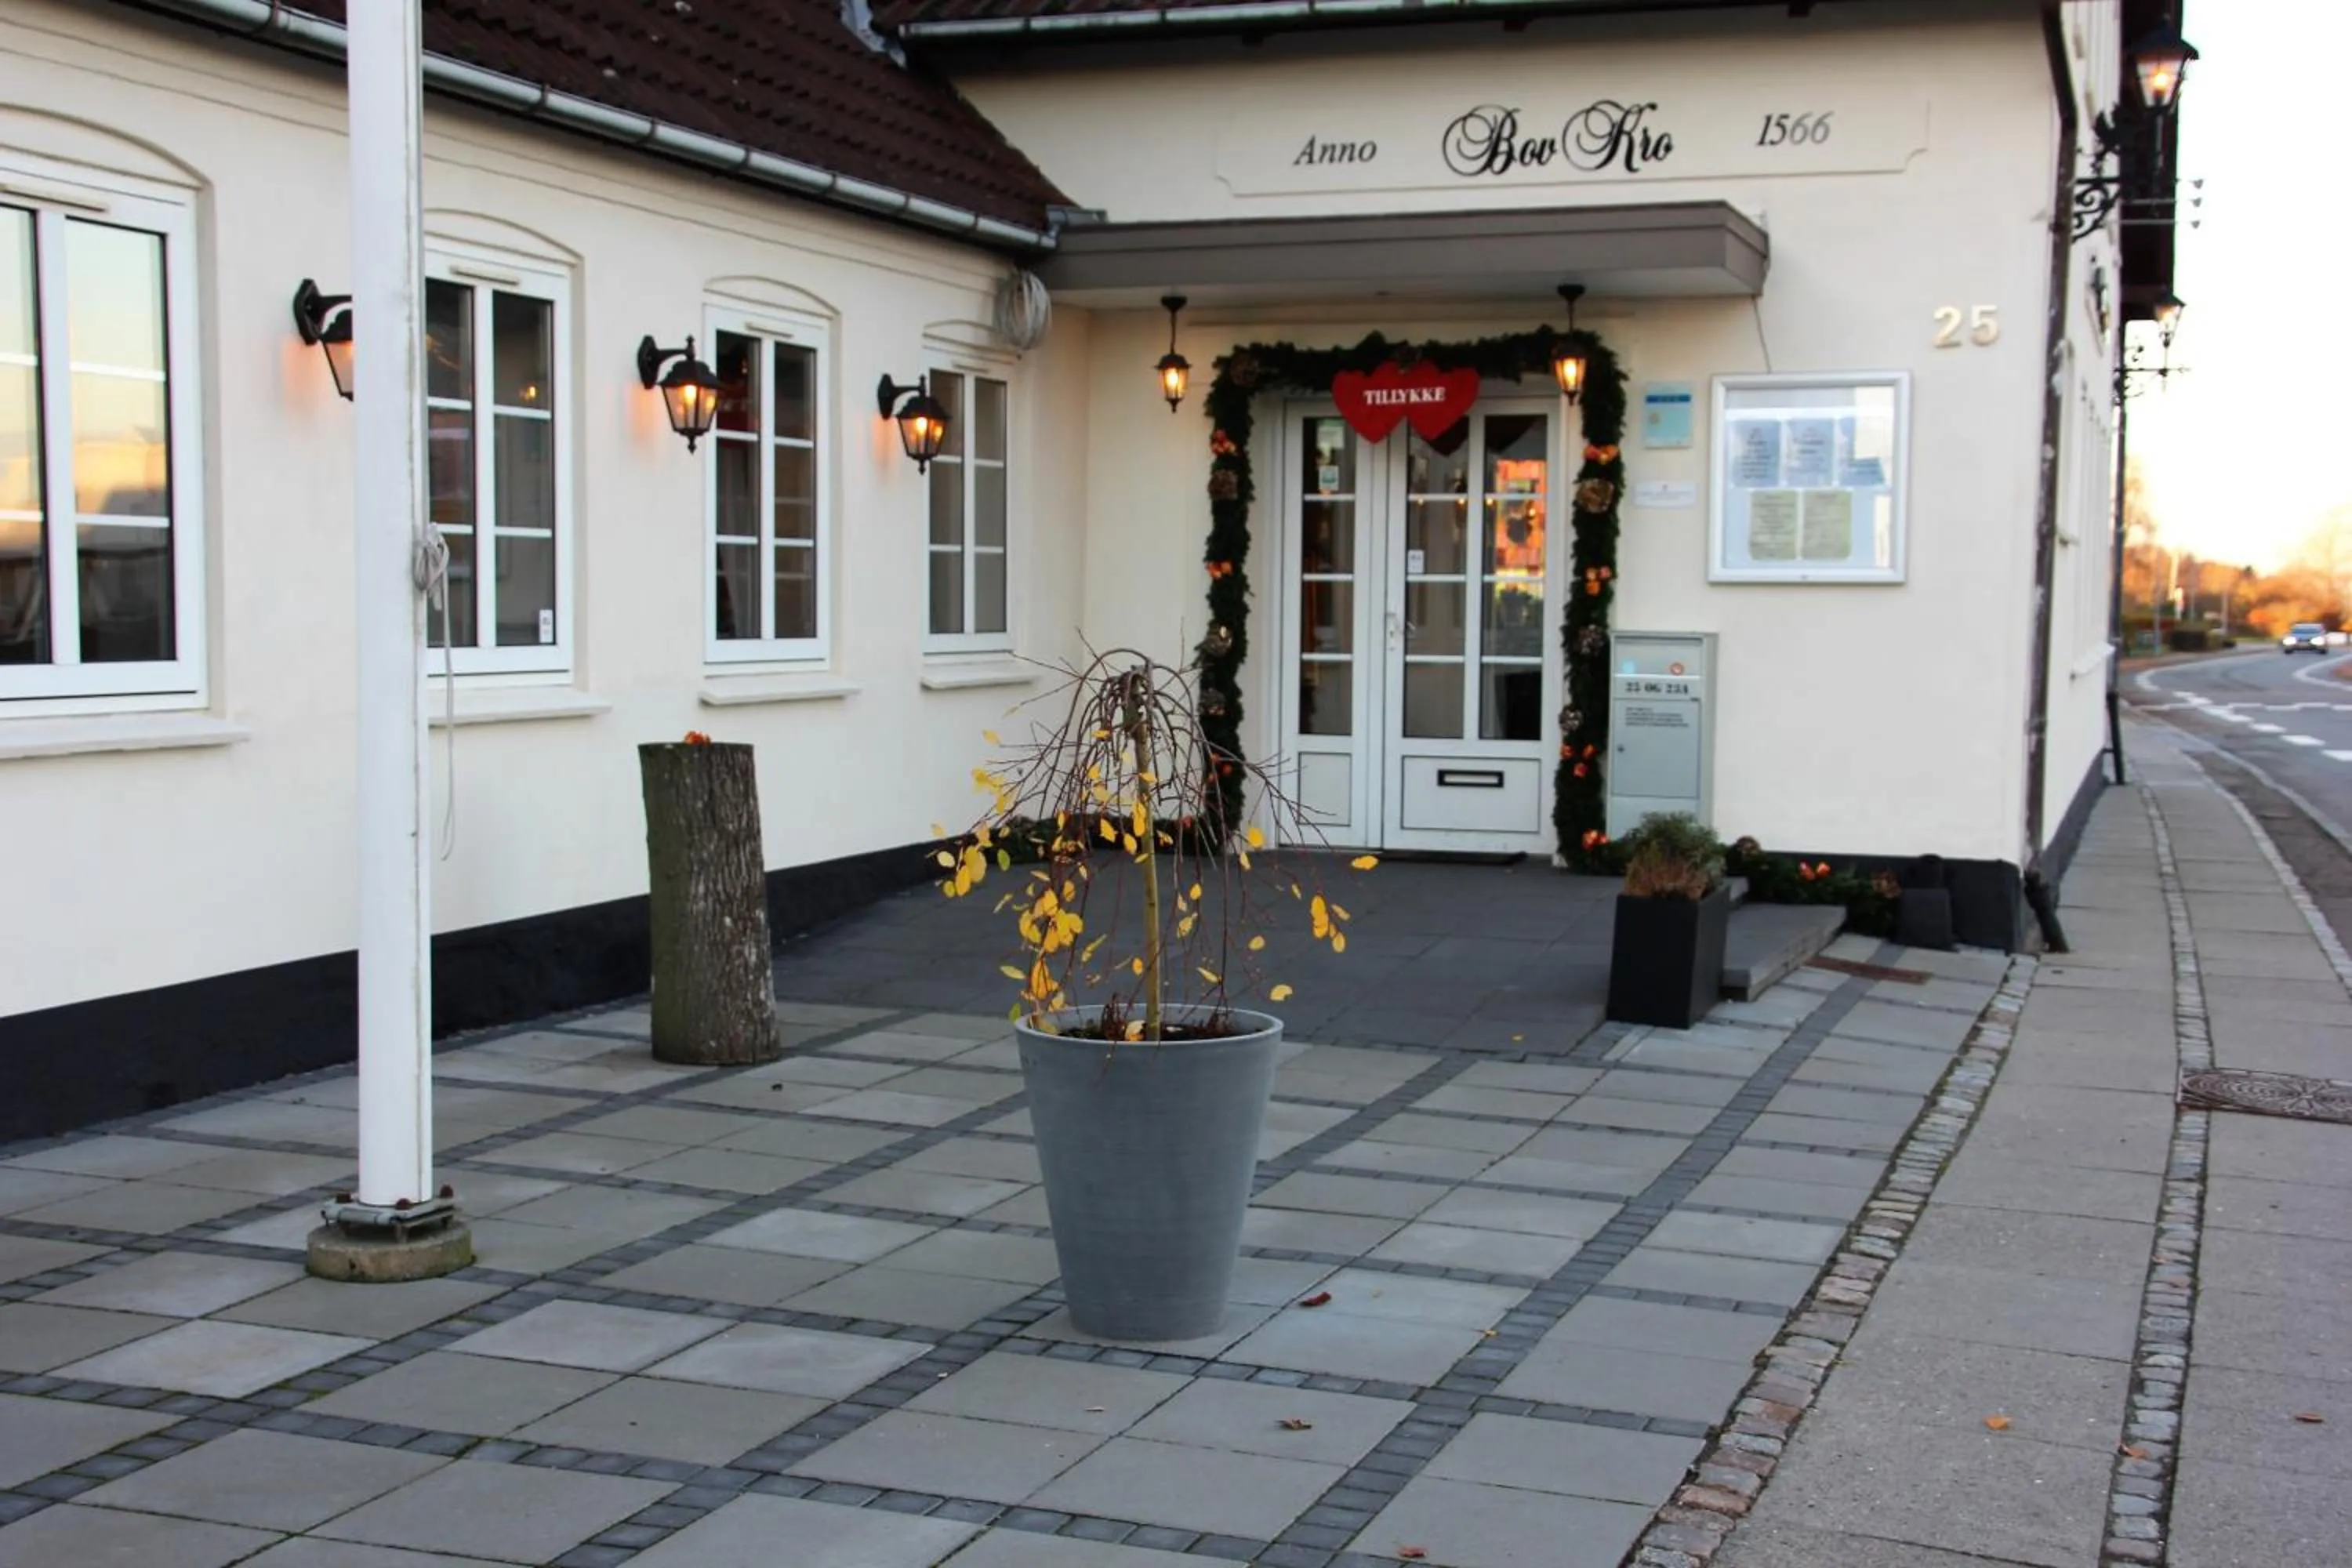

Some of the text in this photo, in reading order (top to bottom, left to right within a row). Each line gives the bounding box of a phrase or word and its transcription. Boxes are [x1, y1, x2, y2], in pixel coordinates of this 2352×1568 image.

[1293, 100, 1835, 177] Anno Bov Kro 1566
[1932, 303, 1999, 349] 25
[1363, 387, 1446, 406] TILLYKKE
